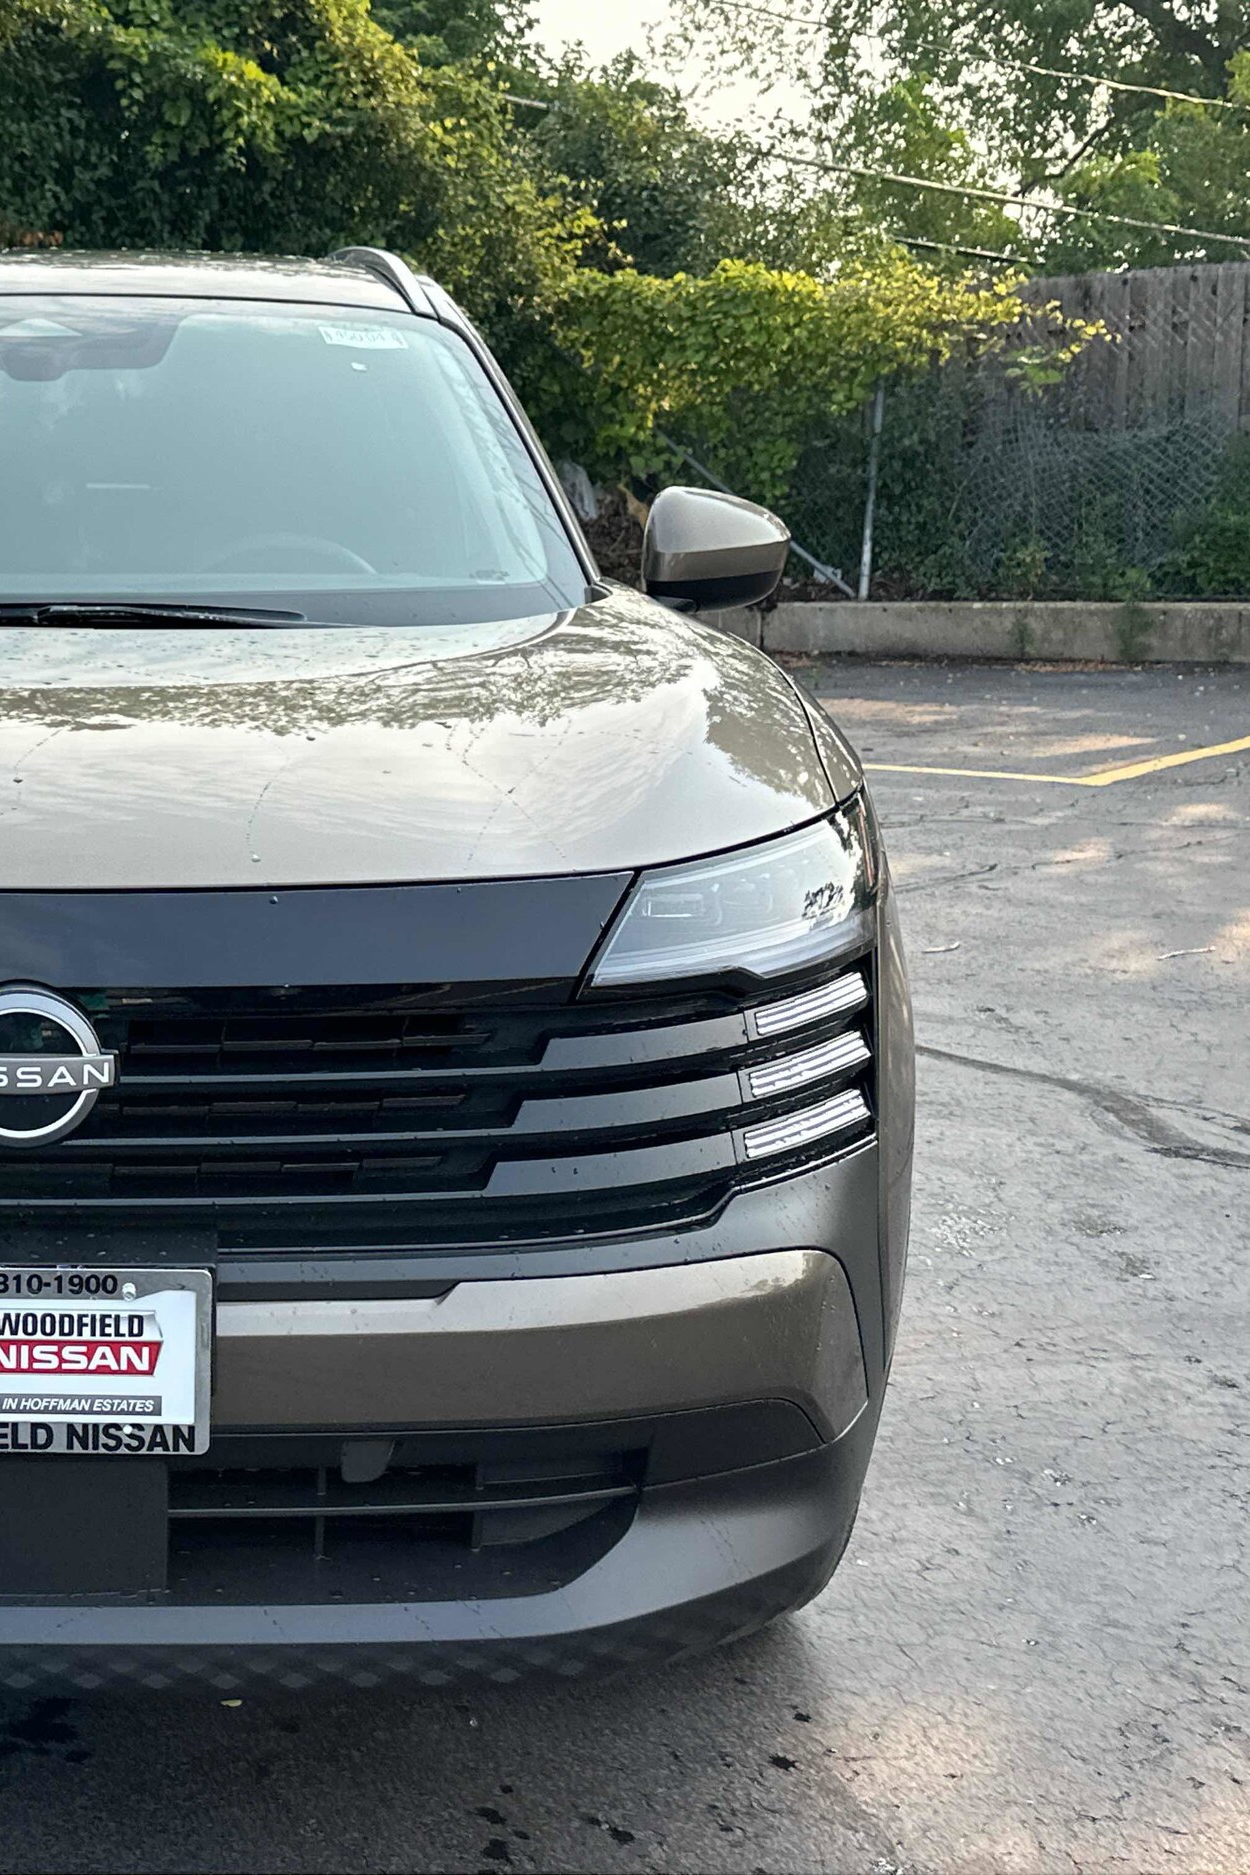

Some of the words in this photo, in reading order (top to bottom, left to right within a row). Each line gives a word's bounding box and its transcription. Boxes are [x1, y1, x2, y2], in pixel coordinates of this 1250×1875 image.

[2, 1397, 18, 1411] IN
[19, 1397, 92, 1412] HOFFMAN
[92, 1398, 155, 1413] ESTATES
[66, 1424, 196, 1453] NISSAN
